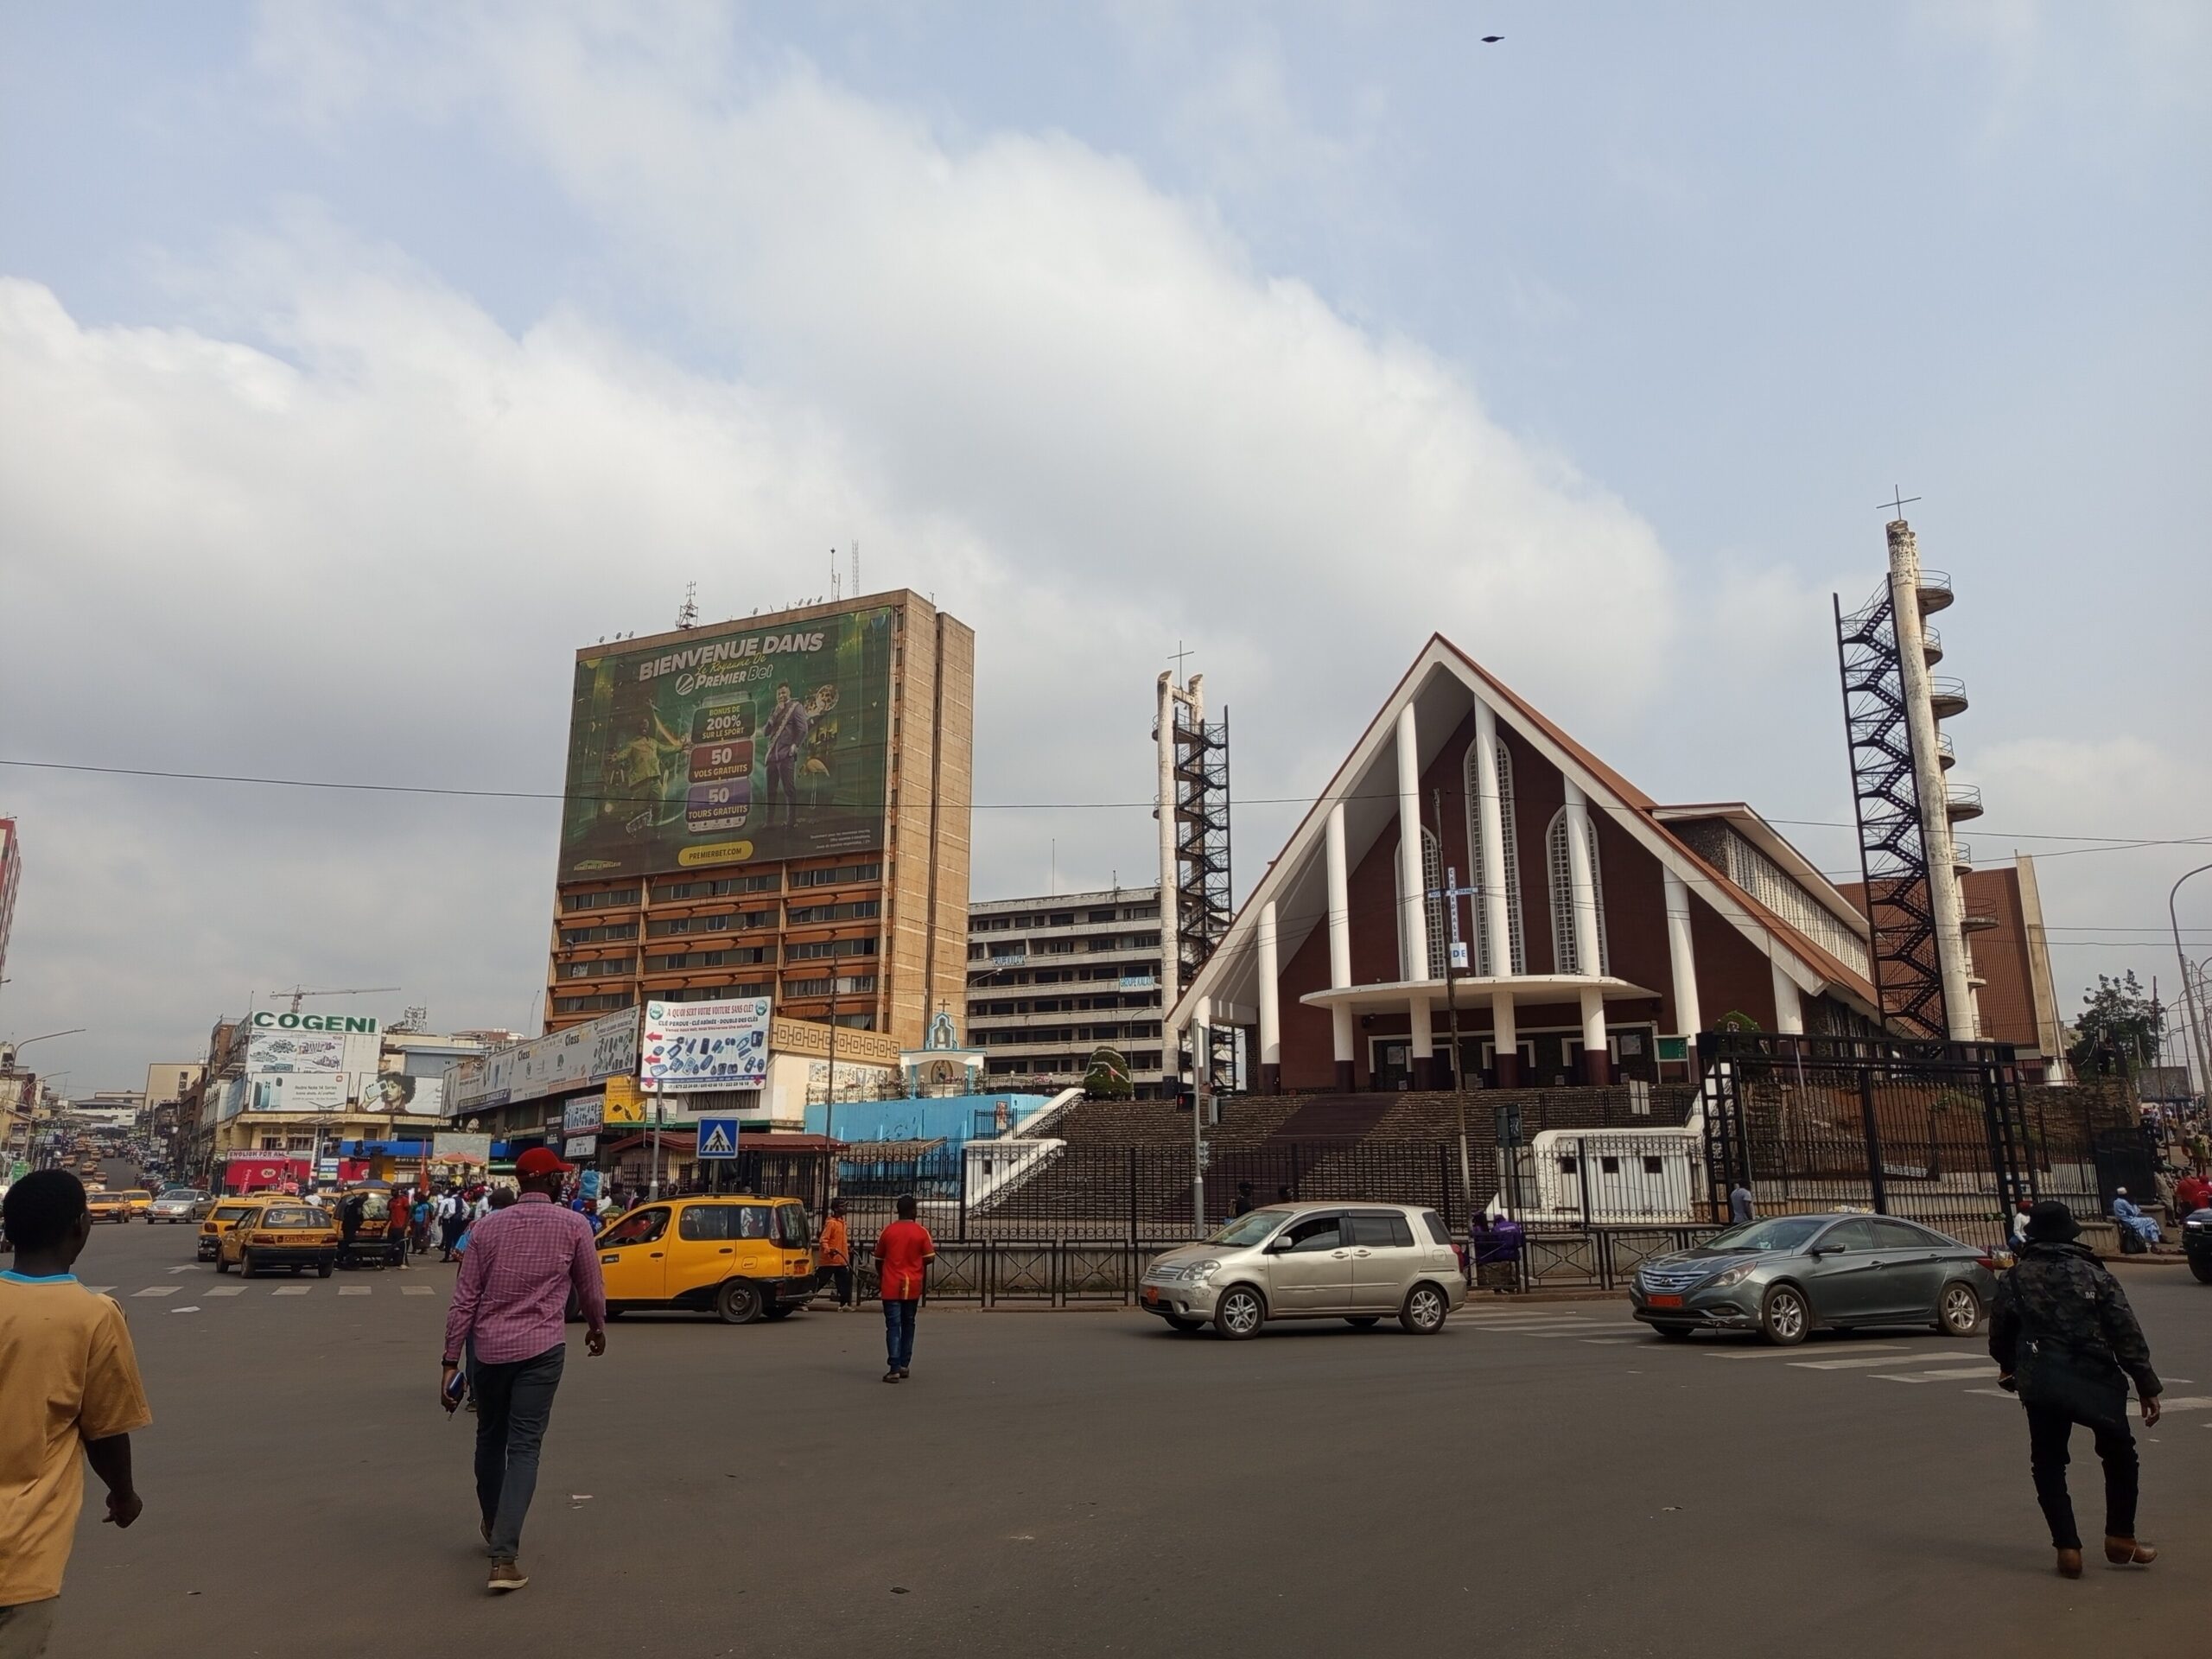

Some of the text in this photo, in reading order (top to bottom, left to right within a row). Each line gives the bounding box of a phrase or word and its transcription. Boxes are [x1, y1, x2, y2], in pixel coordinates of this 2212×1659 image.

[639, 632, 824, 682] BIENVENUE DANS
[747, 664, 773, 681] Bet
[709, 707, 730, 716] BONUS
[706, 714, 741, 731] 200%
[724, 727, 745, 735] SPORT
[711, 747, 733, 766] 50
[694, 764, 748, 779] VOLS GRATUITS
[709, 787, 730, 805] 50
[689, 804, 748, 819] TOURS GRATUITS
[689, 848, 742, 861] PREMIERBET.COM
[686, 1007, 697, 1016] SERT
[697, 1007, 711, 1016] VOTRE
[712, 1005, 731, 1014] VOITURE
[732, 1004, 743, 1014] SANS
[253, 1012, 377, 1033] COGENI
[565, 1033, 580, 1046] Class
[518, 1050, 531, 1062] Class
